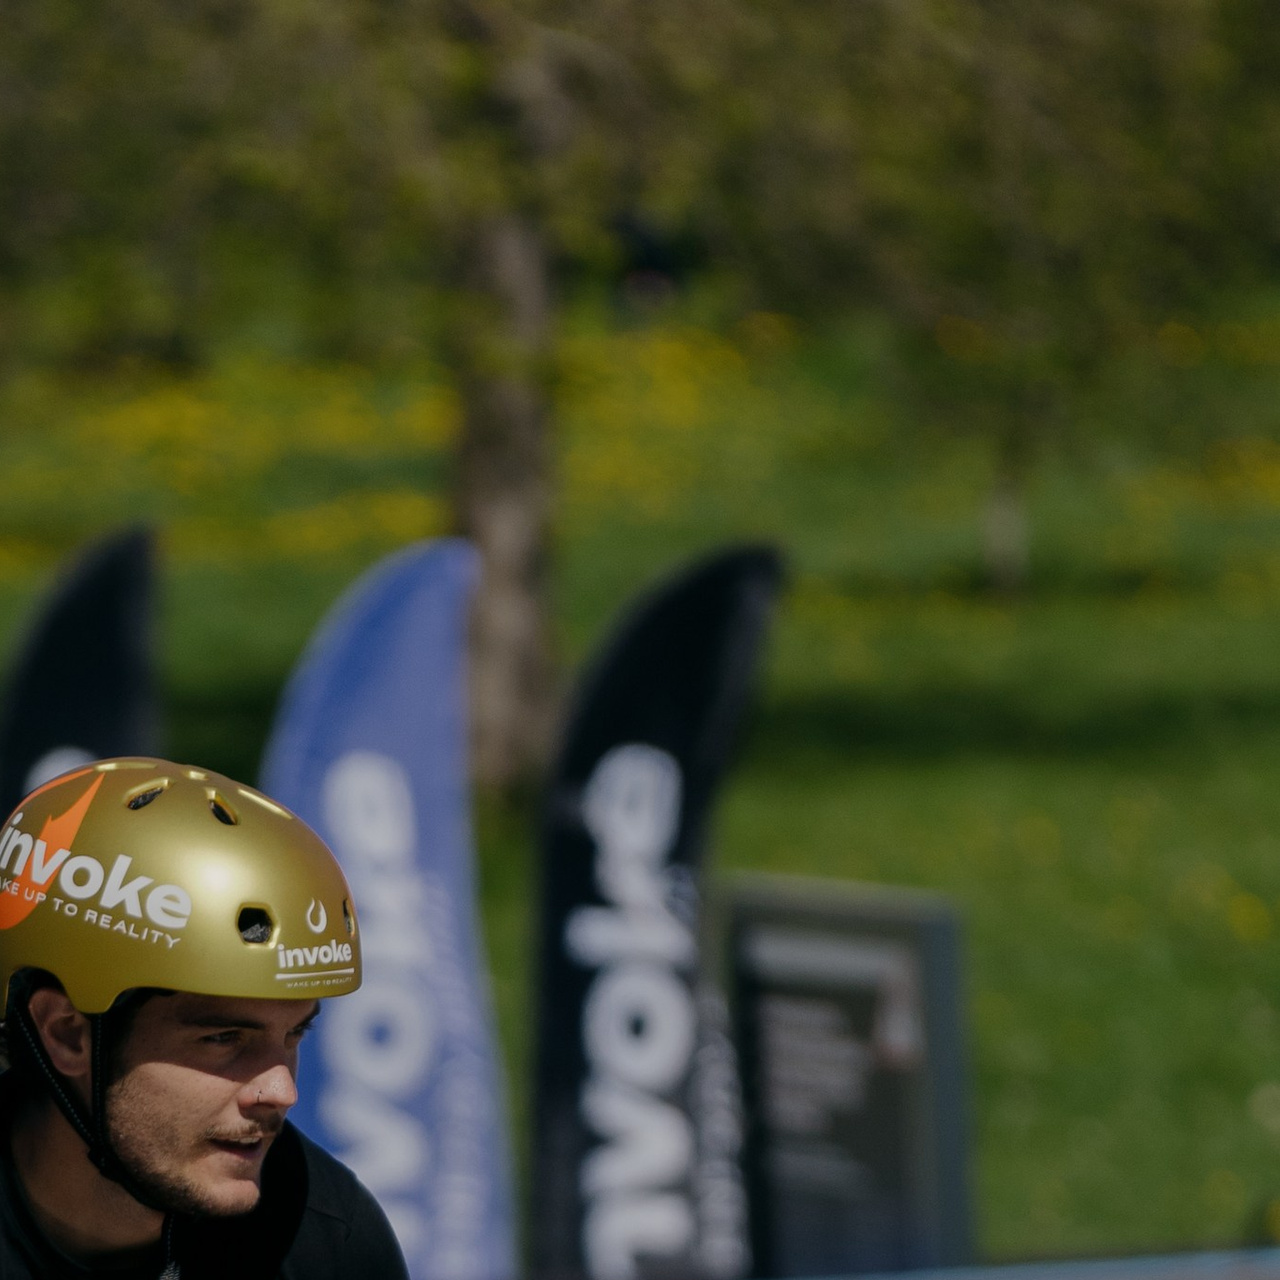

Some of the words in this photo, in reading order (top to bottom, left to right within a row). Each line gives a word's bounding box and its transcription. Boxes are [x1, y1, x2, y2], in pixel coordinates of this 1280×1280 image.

[24, 887, 47, 904] UP
[53, 898, 78, 916] TO
[84, 909, 181, 949] REALITY
[277, 938, 353, 969] invoke
